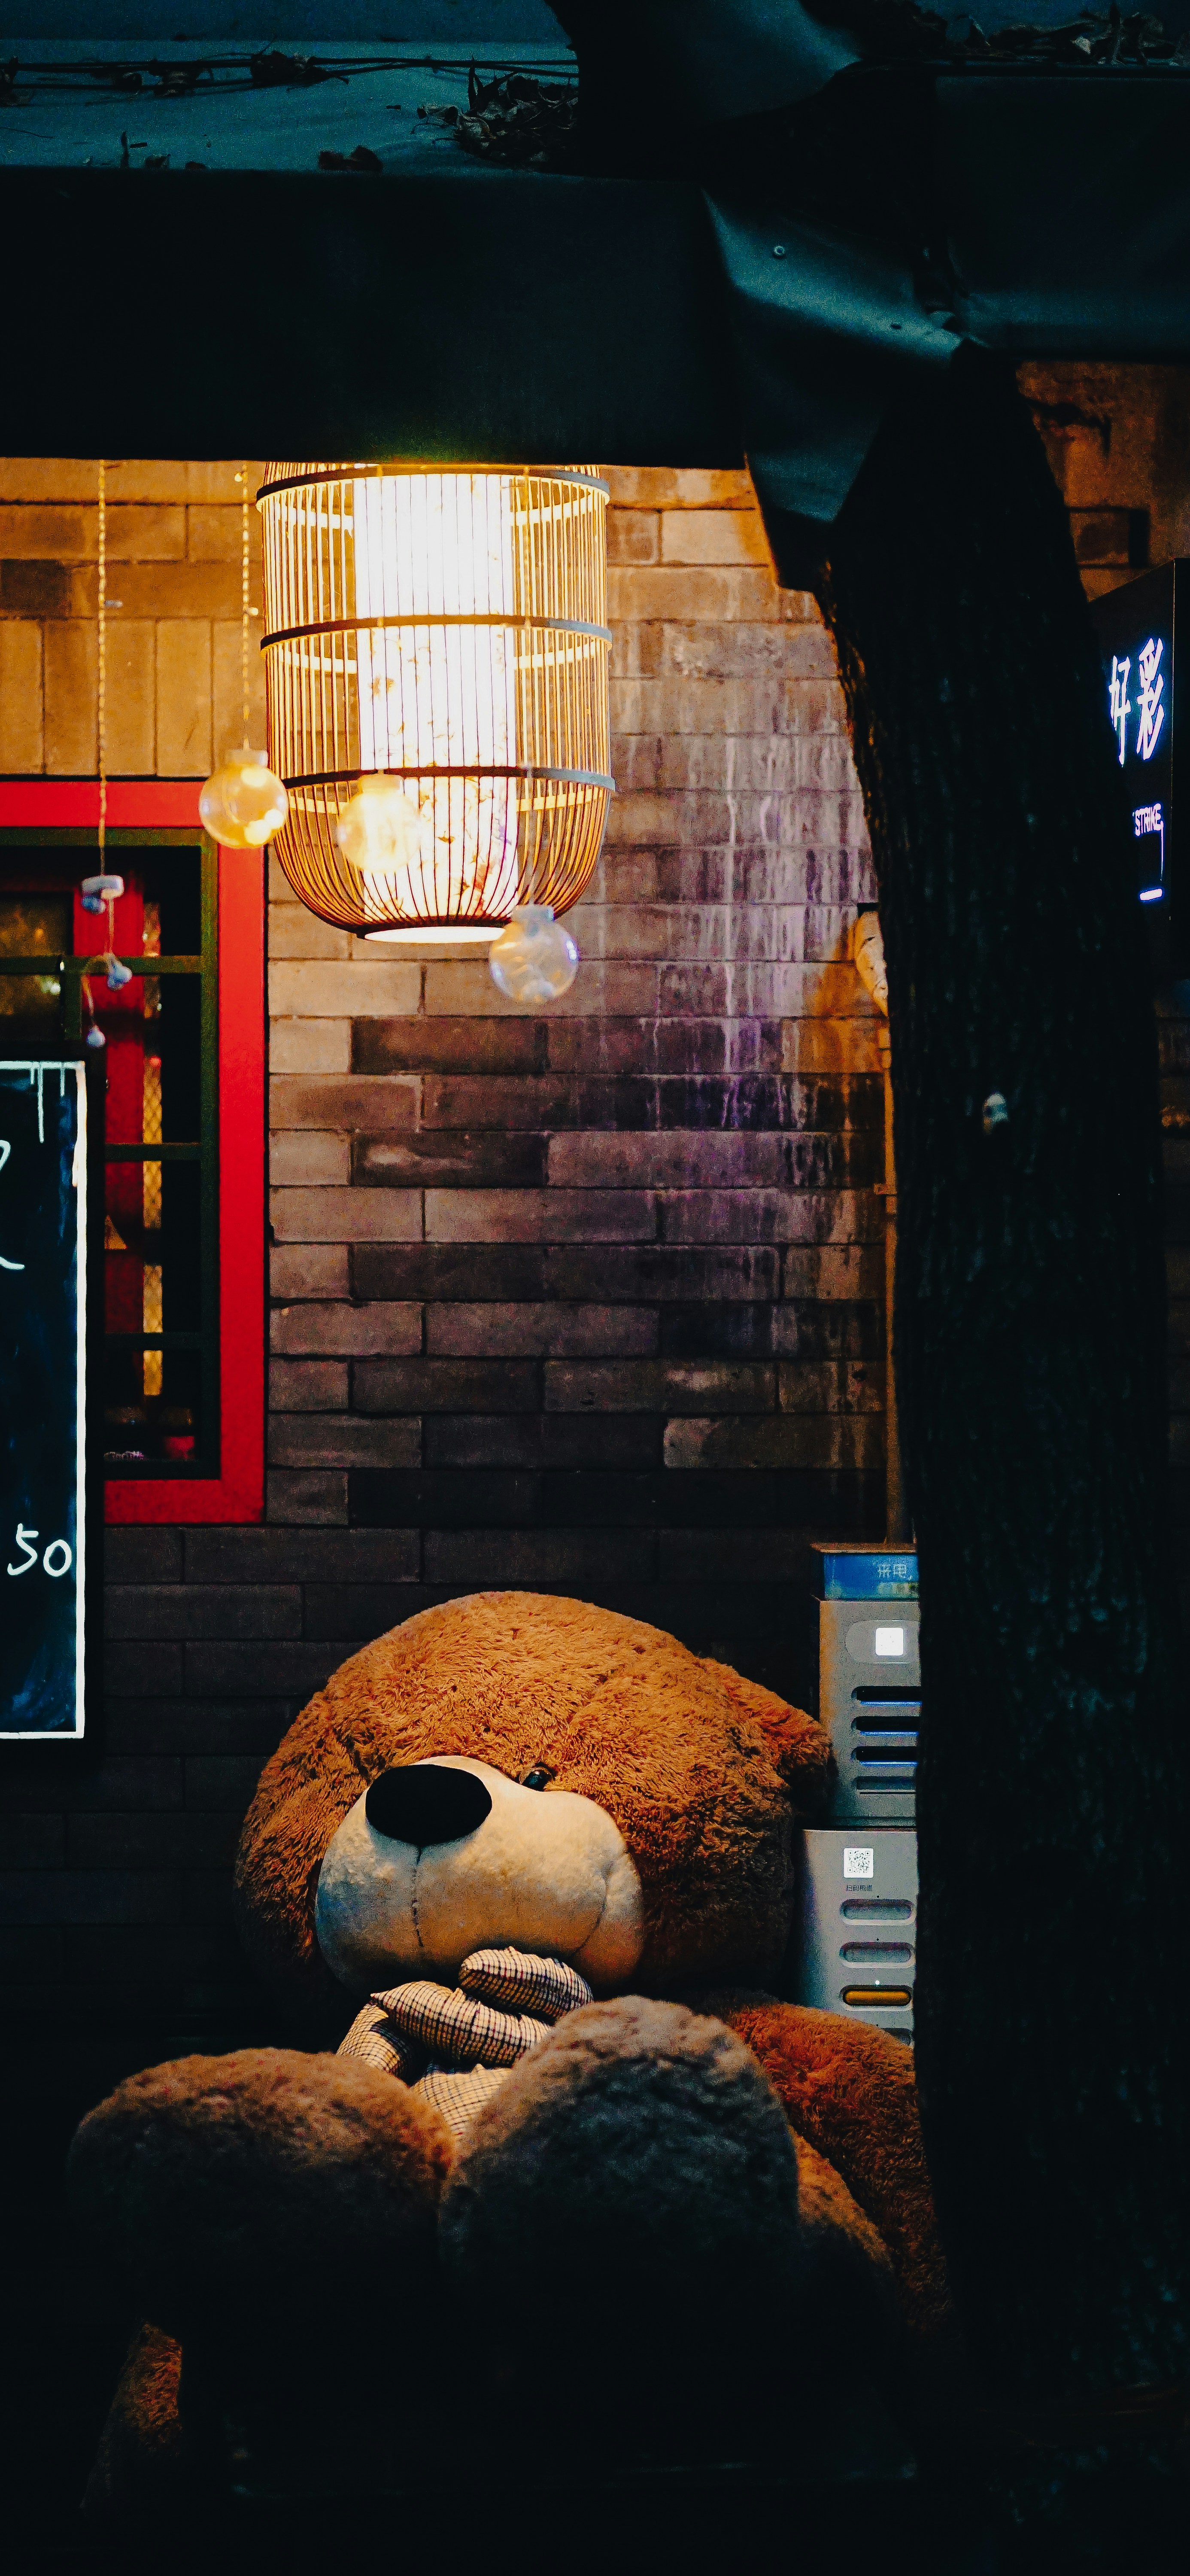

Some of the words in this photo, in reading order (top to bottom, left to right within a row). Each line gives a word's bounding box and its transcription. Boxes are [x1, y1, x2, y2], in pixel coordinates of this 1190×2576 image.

[1109, 638, 1164, 765] 好彩
[1135, 803, 1162, 836] STRIKE
[7, 1523, 72, 1577] 50
[877, 1563, 912, 1581] 来电
